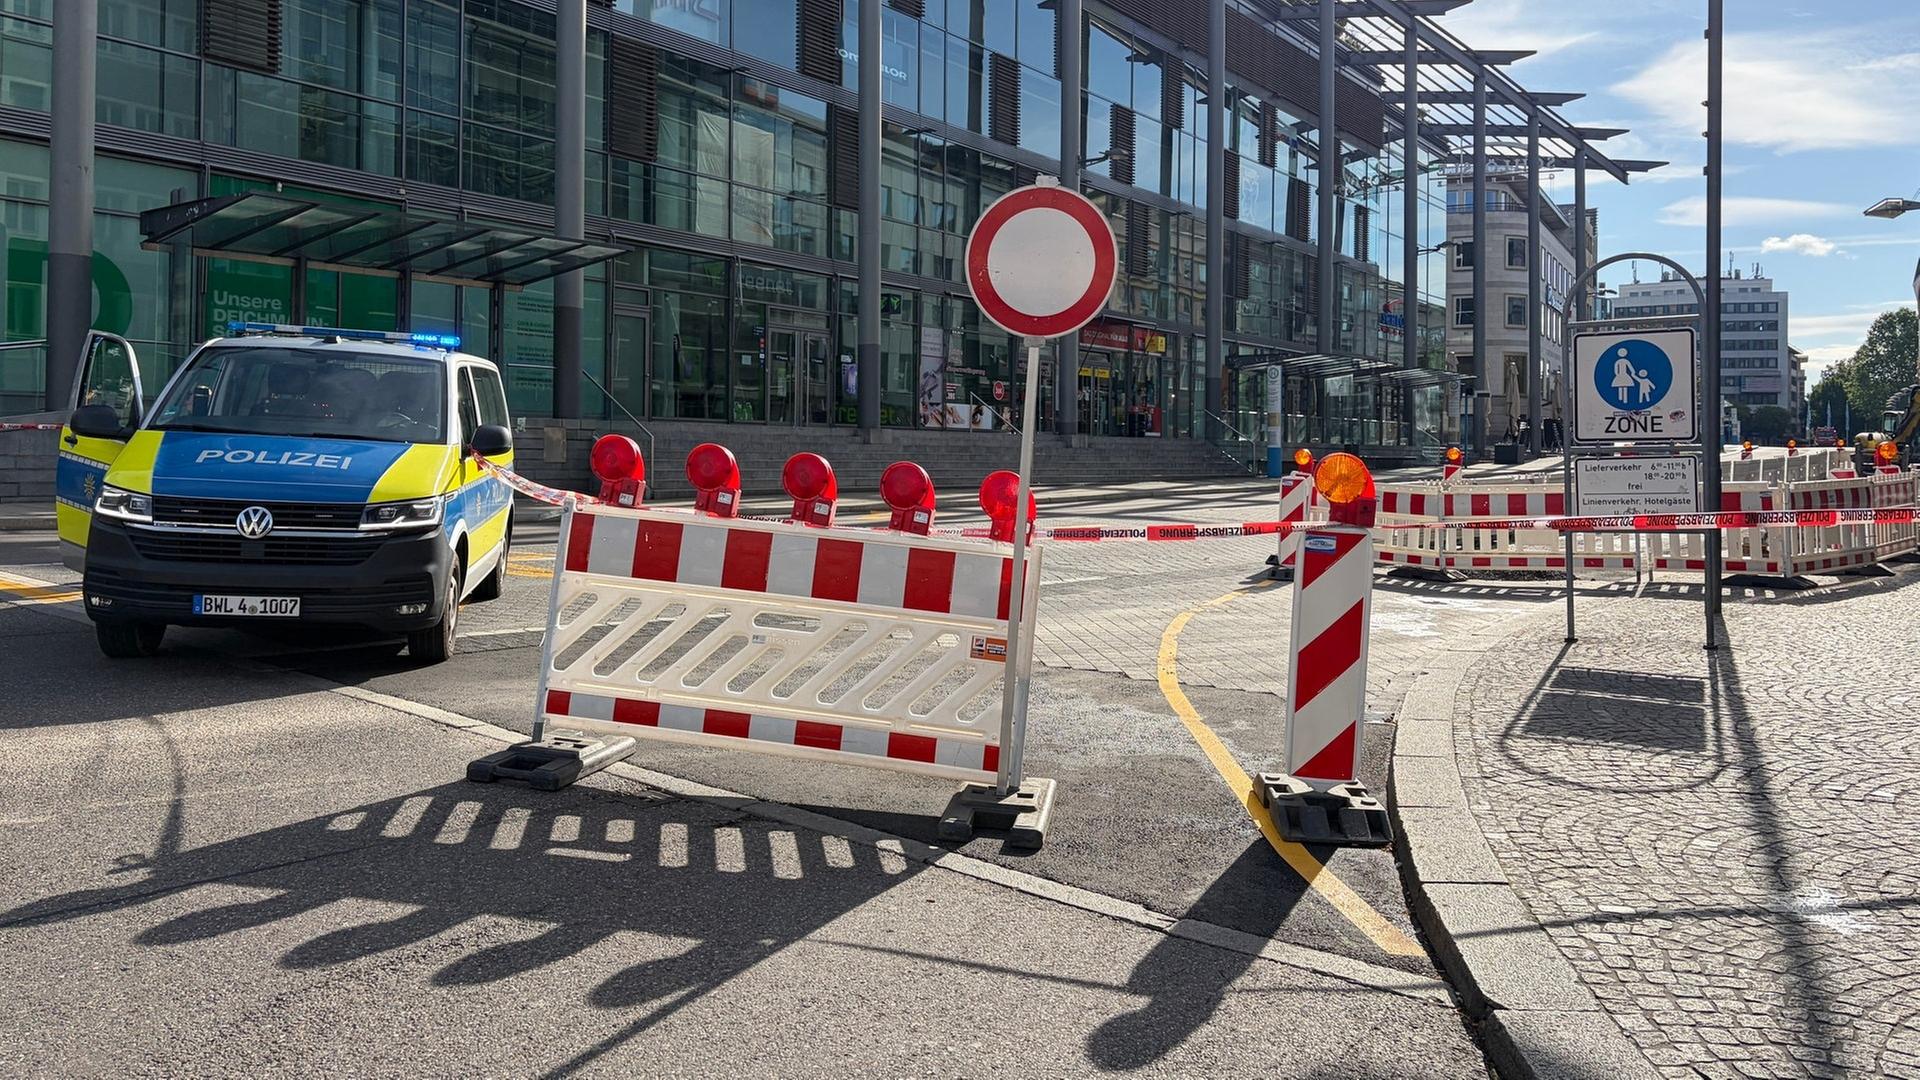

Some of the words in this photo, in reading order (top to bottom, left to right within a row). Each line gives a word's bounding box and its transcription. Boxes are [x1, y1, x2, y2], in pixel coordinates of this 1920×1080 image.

[213, 289, 282, 310] Unsere
[1604, 416, 1663, 433] ZONE
[195, 450, 352, 470] POLIZEI
[1585, 464, 1642, 472] Lieferverkehr
[1628, 482, 1643, 490] frei
[1644, 497, 1691, 506] Hotelgäste
[1745, 511, 1830, 524] POLIZEIABSPERRUNG
[1159, 524, 1262, 539] POLIZEIABSPERRUNG
[203, 597, 233, 613] BWL
[238, 598, 247, 613] 4
[259, 599, 298, 614] 1007
